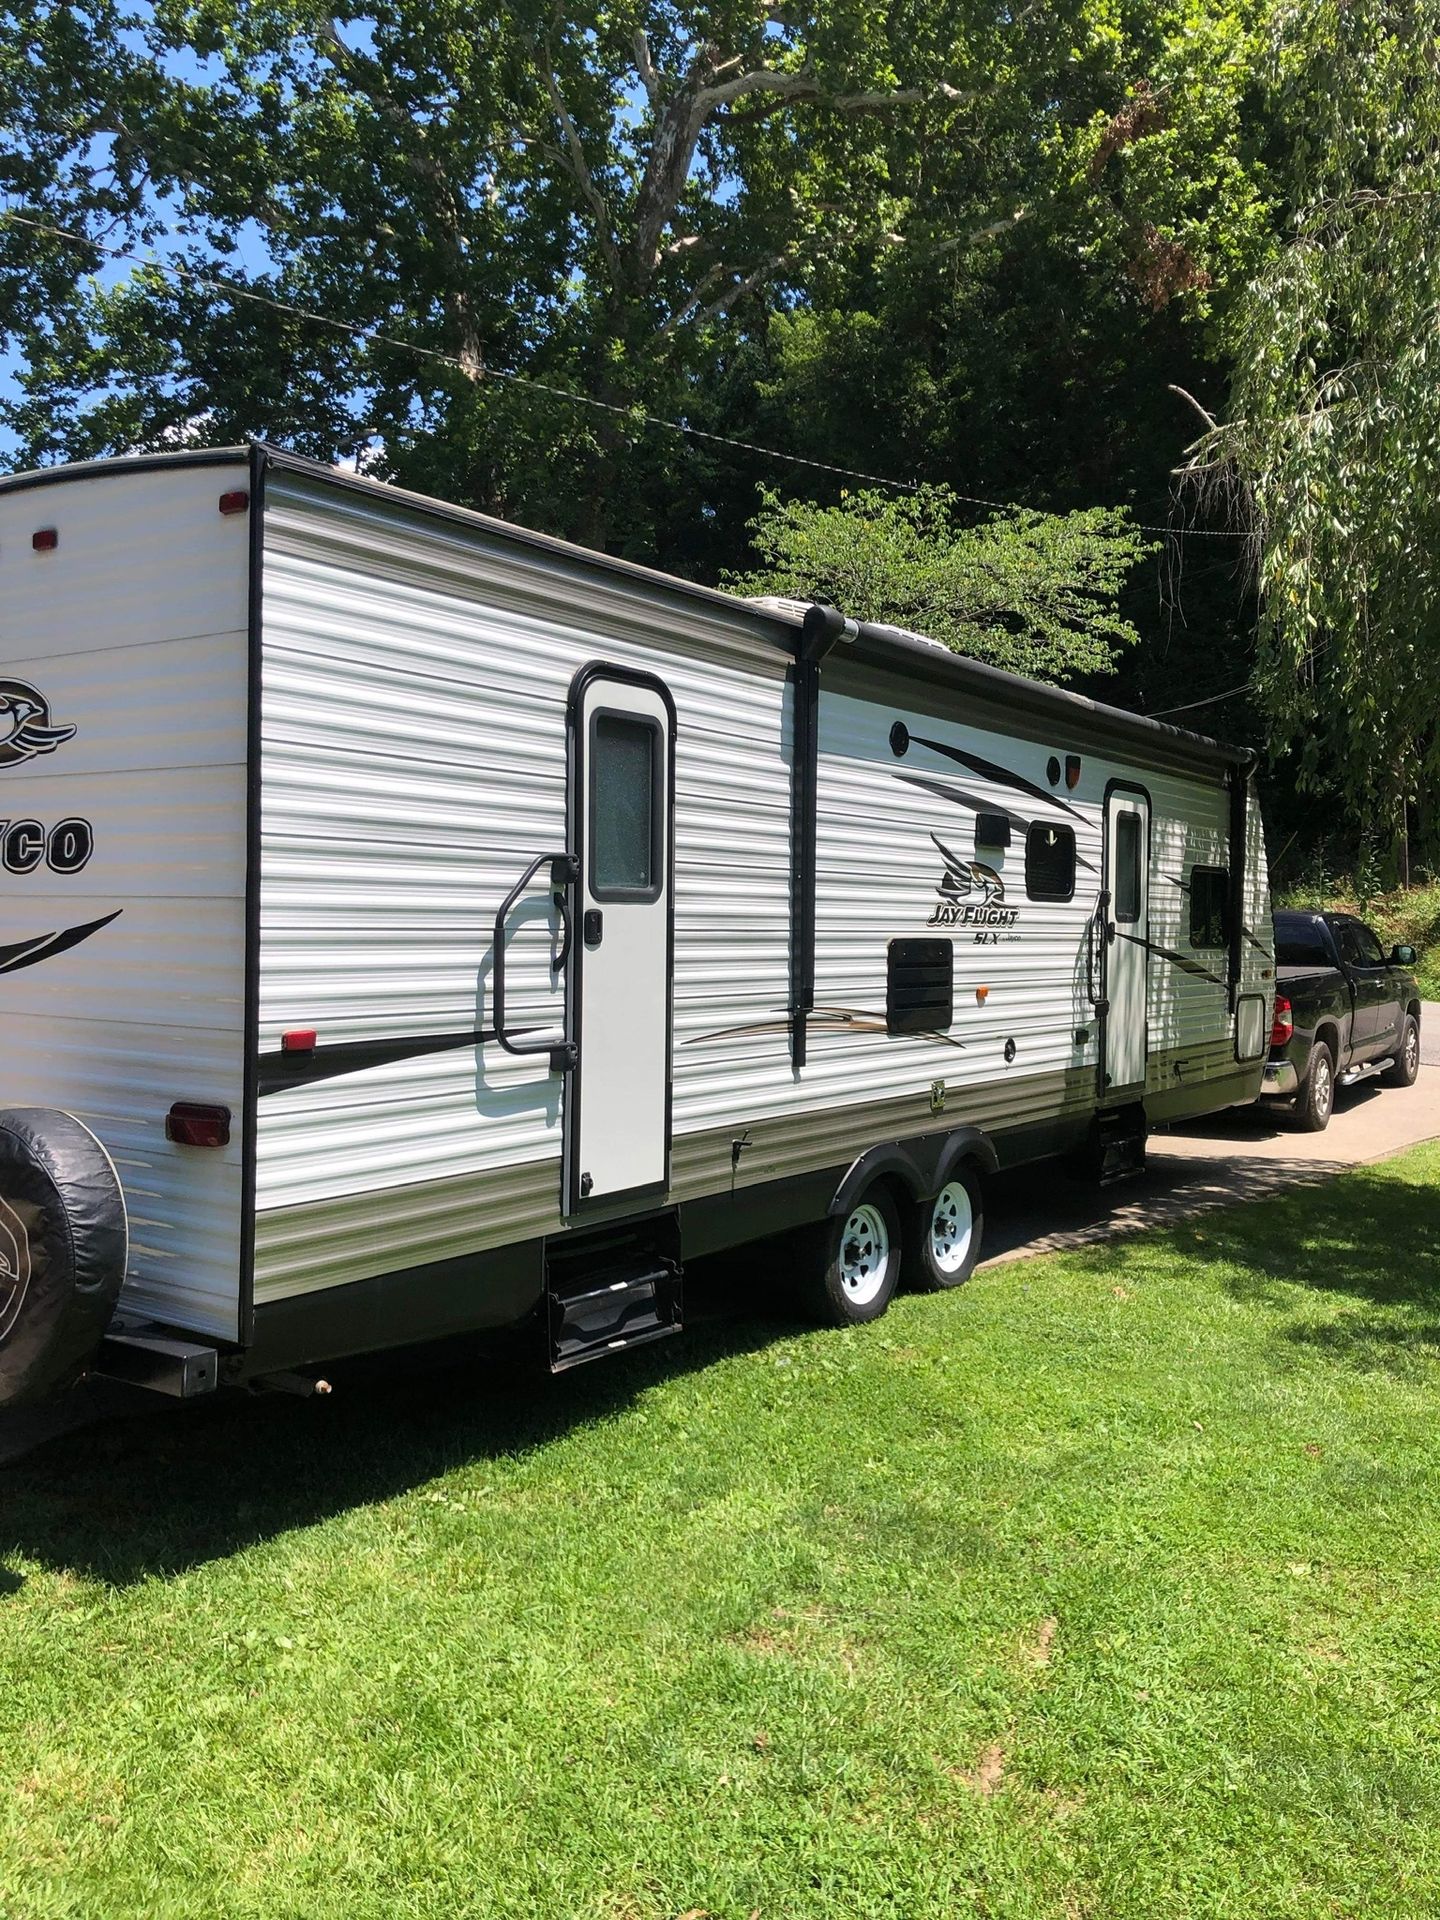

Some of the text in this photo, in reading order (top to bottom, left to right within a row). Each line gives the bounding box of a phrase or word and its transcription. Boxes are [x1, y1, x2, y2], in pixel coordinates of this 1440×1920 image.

[0, 818, 94, 875] CO
[927, 903, 1019, 928] JAY FLIGHT
[973, 932, 1000, 944] SLX
